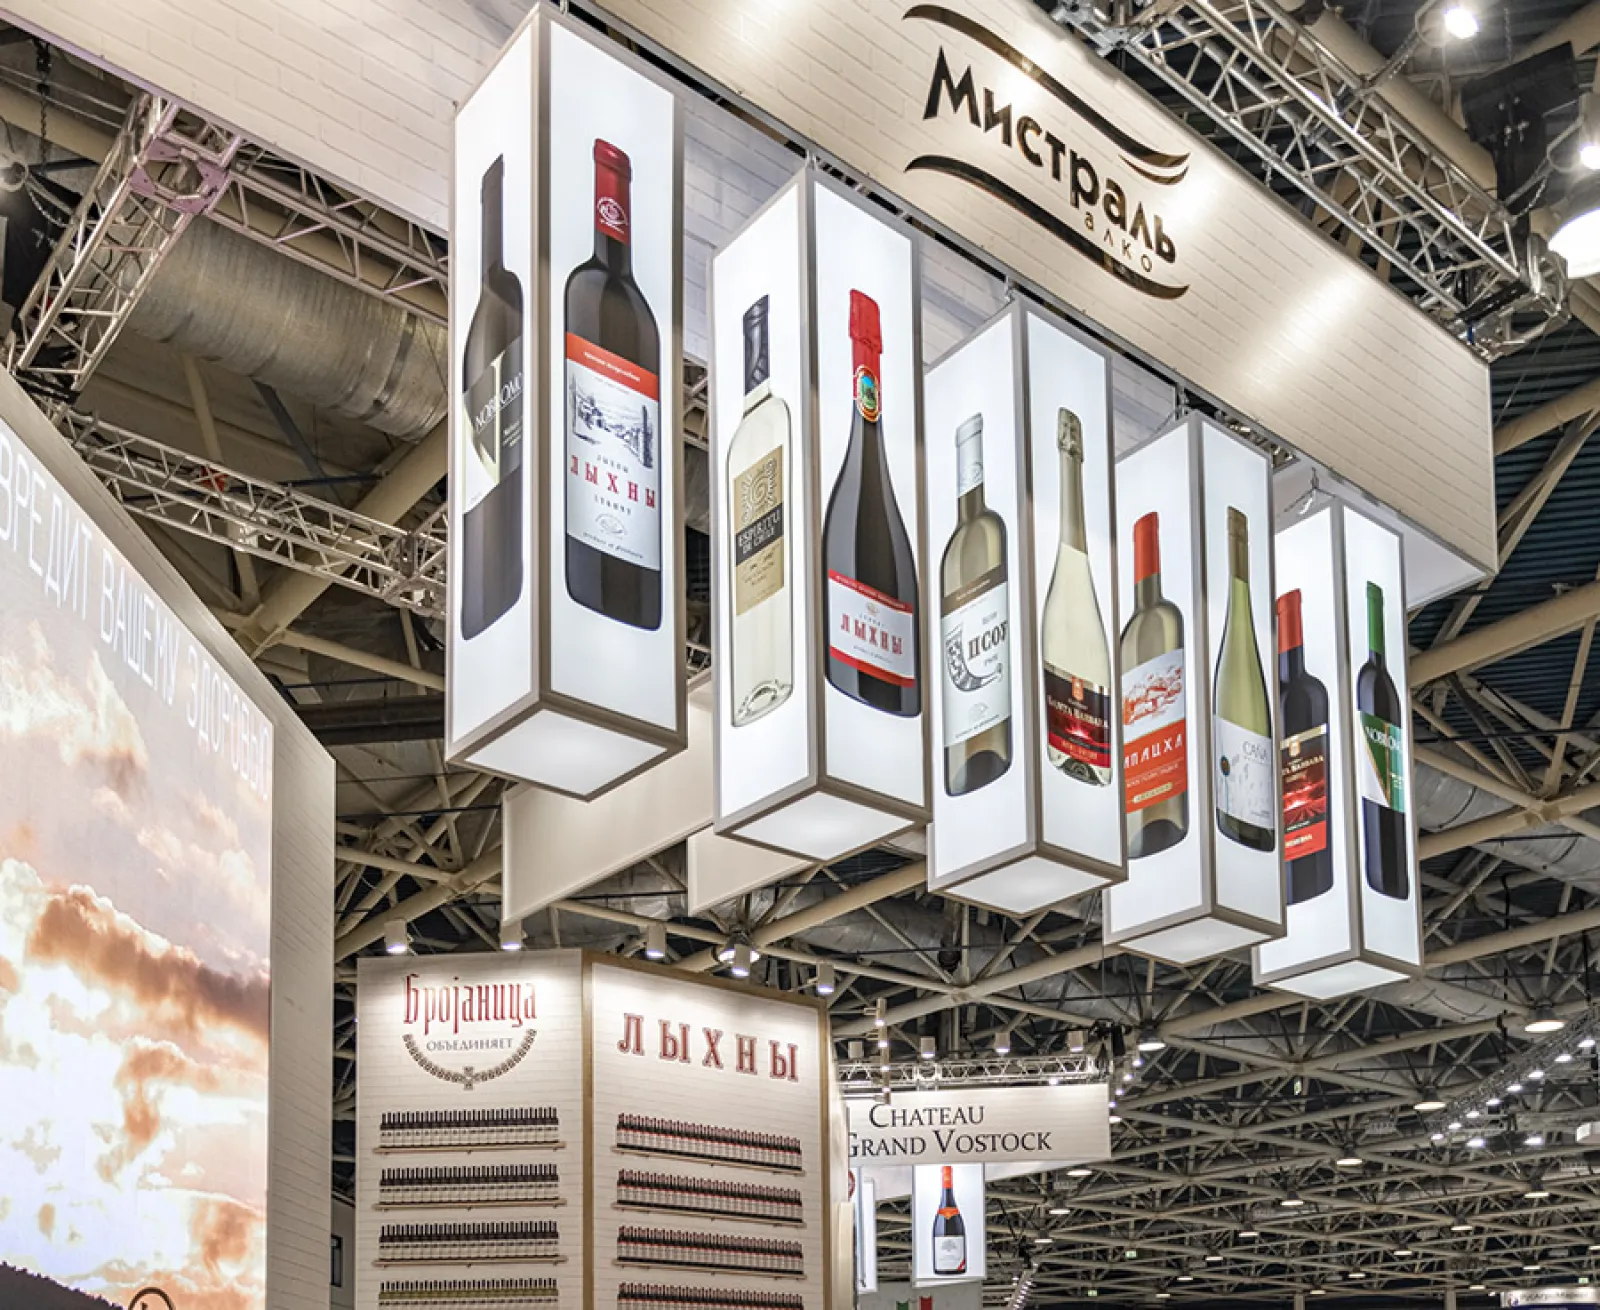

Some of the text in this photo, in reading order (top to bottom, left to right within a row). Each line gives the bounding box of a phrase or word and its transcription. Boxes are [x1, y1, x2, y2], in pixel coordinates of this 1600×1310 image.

[923, 44, 1176, 264] Мистраль
[100, 548, 181, 706] ВАШЕМУ
[617, 1012, 799, 1082] ЛЫХНЫ
[933, 1128, 1053, 1154] VOSTOCK
